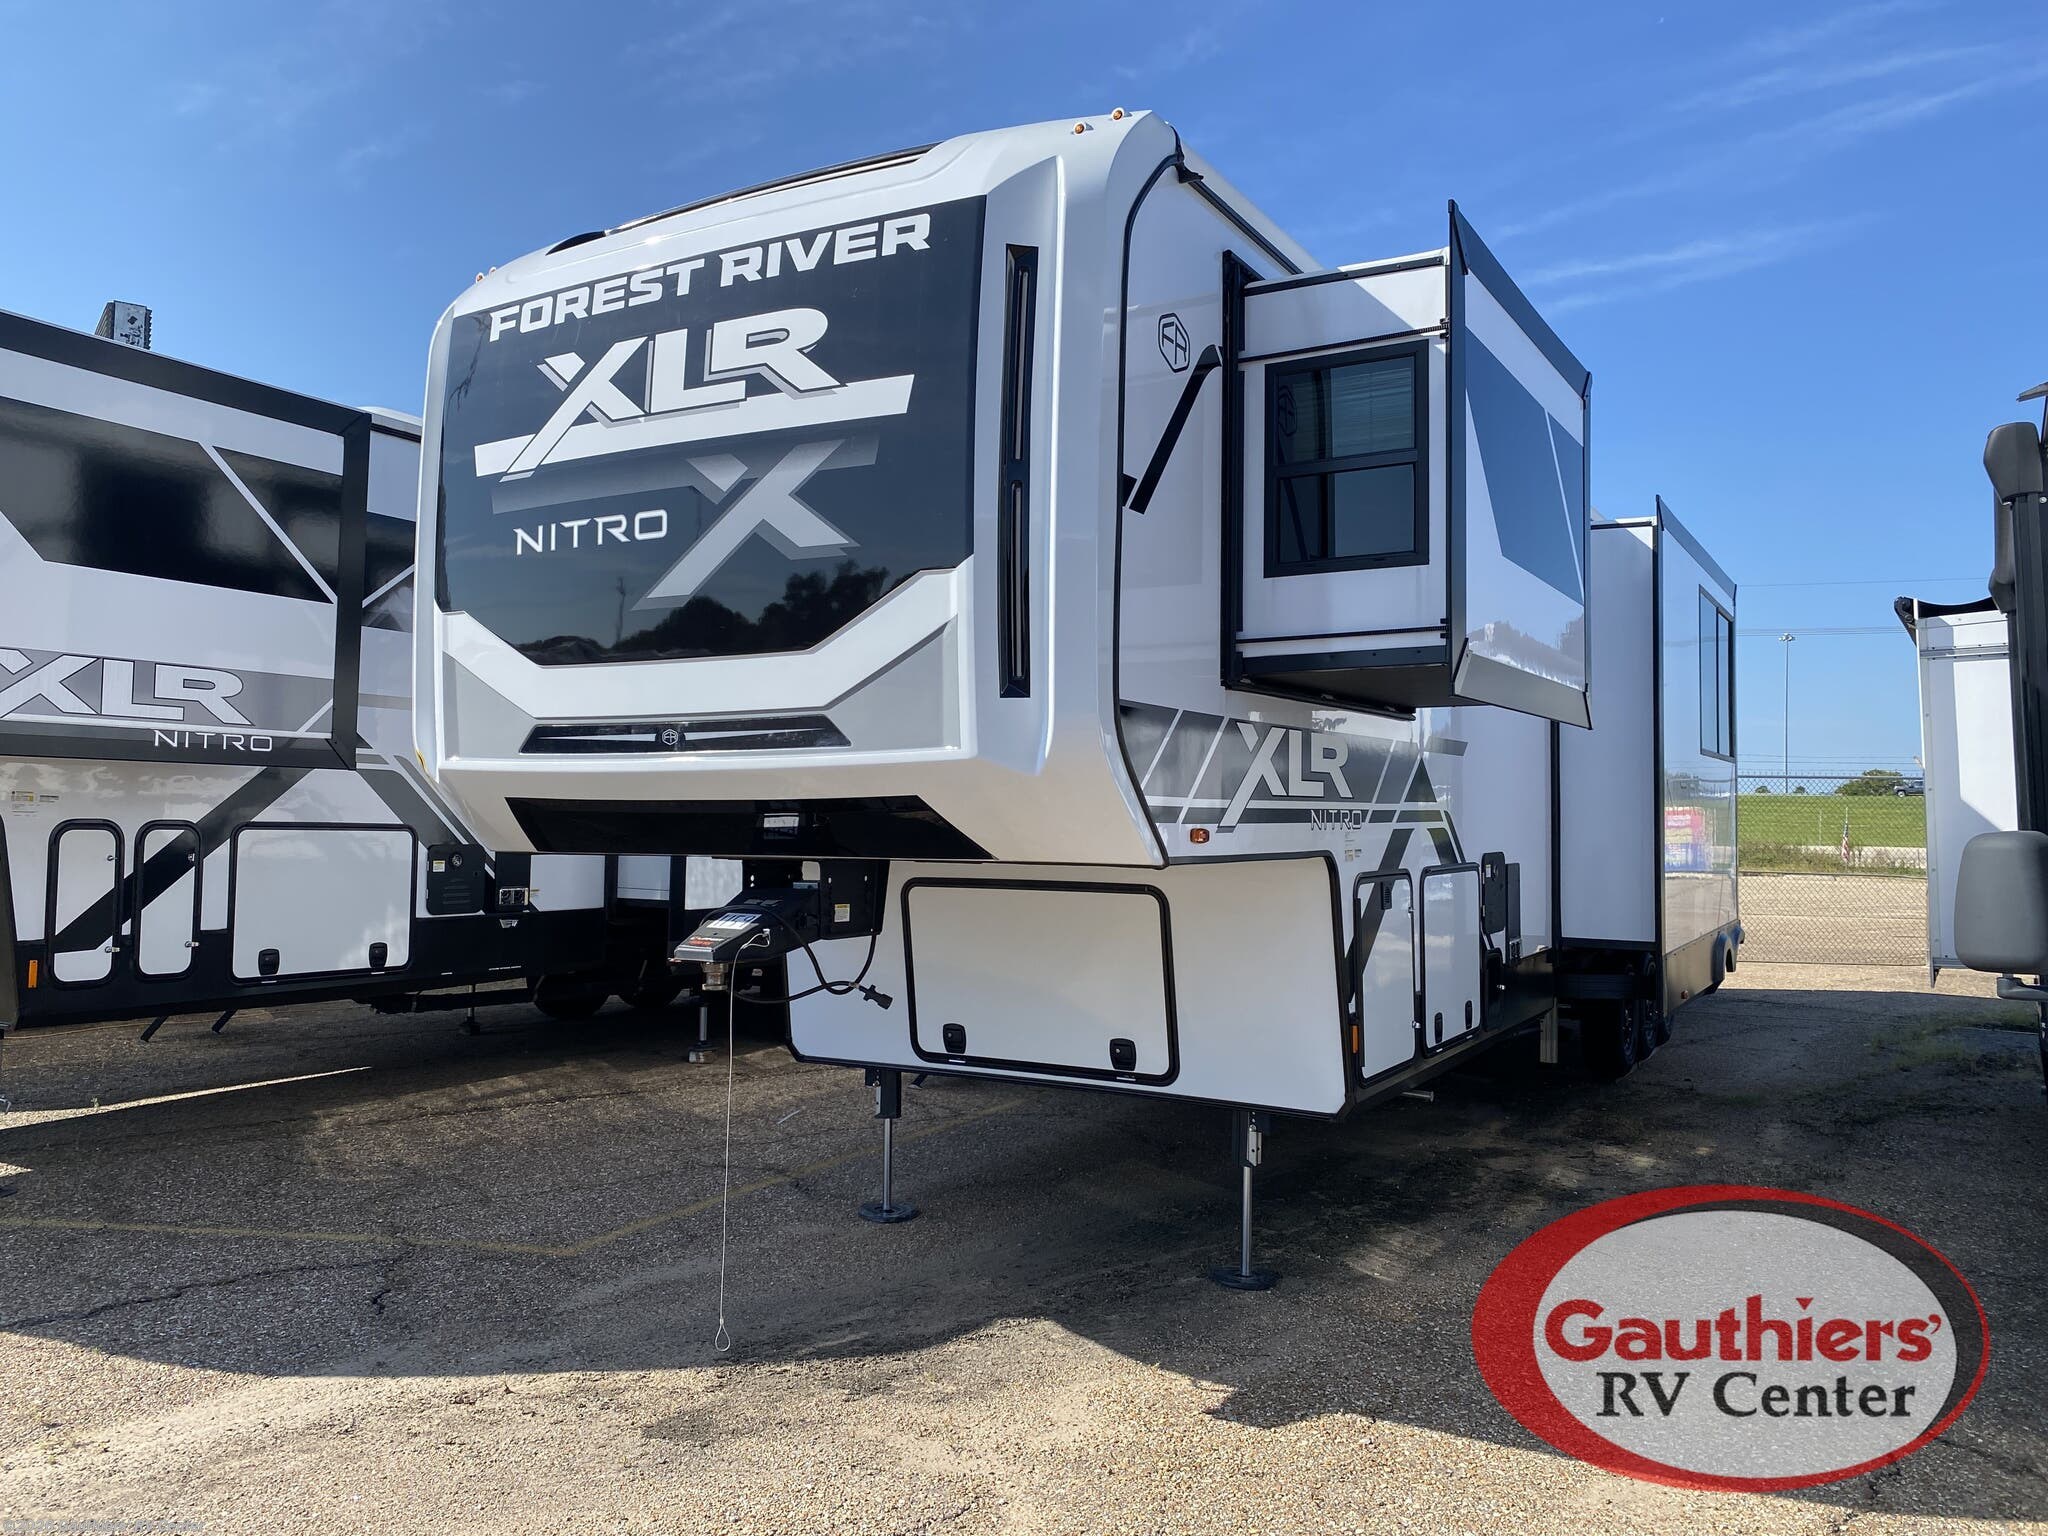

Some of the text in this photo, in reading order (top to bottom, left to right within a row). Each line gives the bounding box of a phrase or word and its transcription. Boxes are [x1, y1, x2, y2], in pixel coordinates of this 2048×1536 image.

[488, 212, 932, 343] FOREST RIVER
[500, 307, 844, 482] XLR
[513, 508, 668, 556] NITRO
[0, 648, 255, 727] XLR
[153, 729, 273, 752] NITRO
[1217, 721, 1354, 832] XLR
[1310, 808, 1363, 831] NITRO
